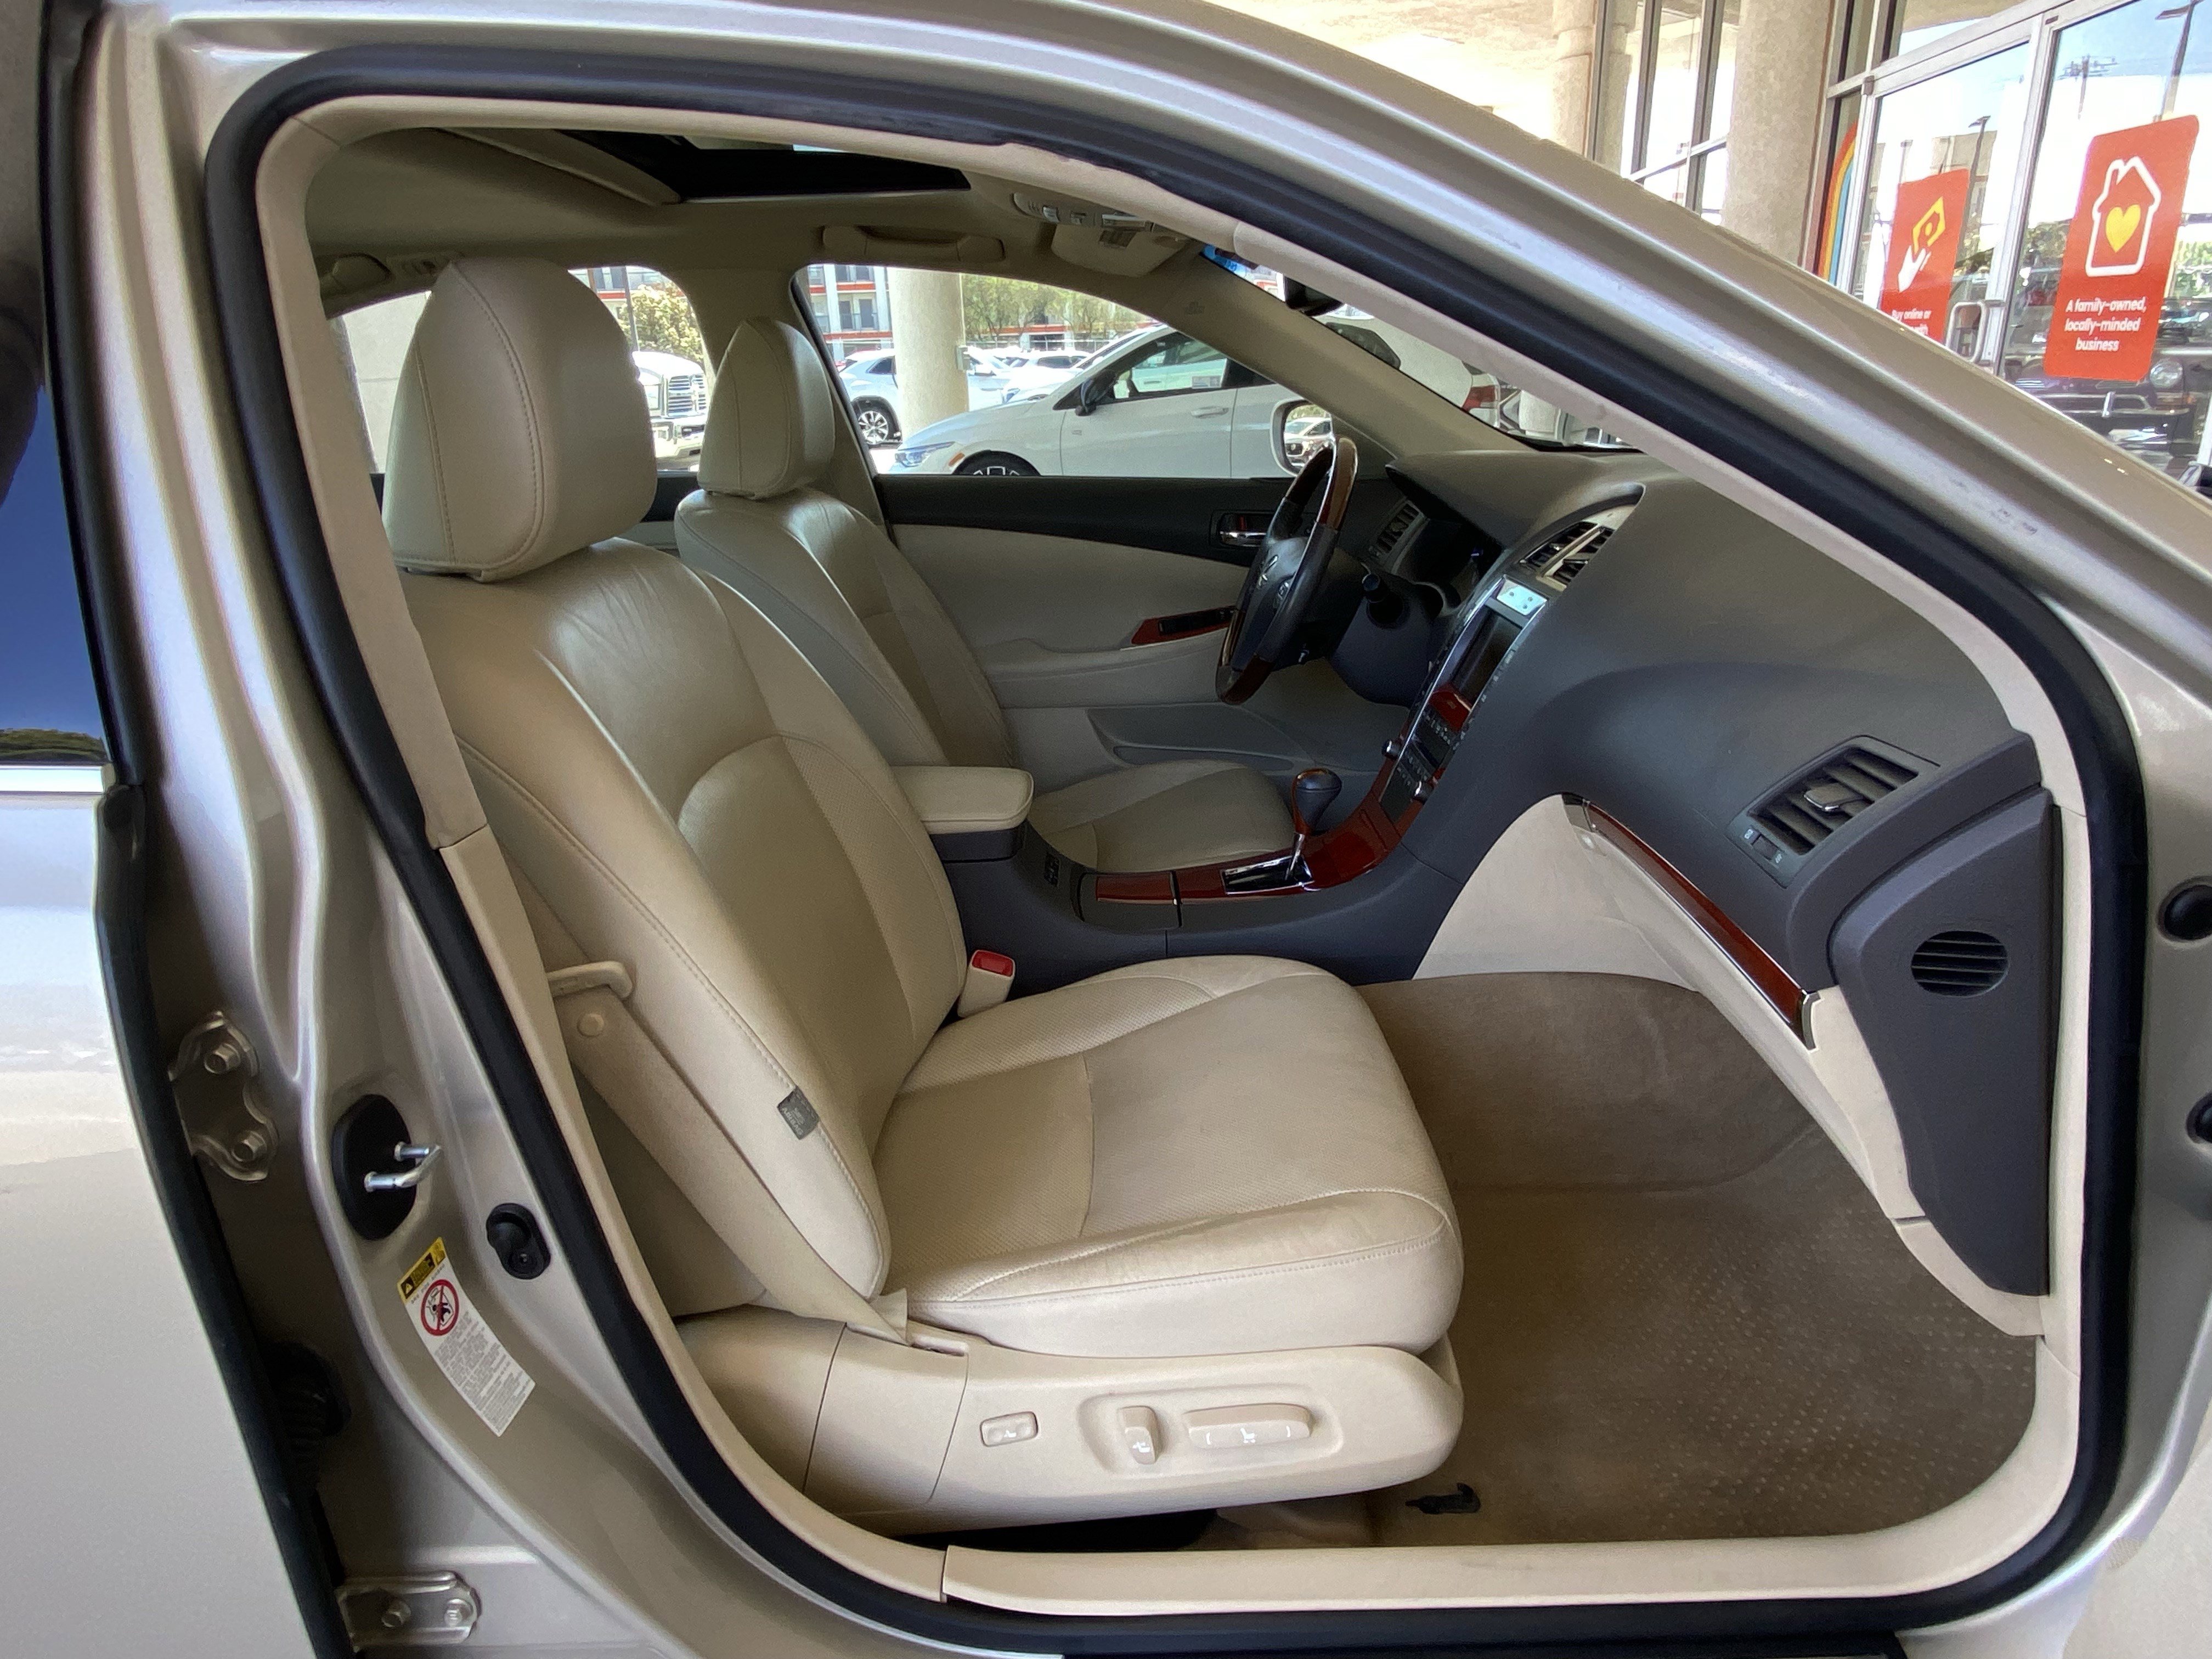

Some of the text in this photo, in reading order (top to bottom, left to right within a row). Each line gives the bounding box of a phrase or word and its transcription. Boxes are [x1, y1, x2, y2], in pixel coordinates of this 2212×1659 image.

[2065, 296, 2147, 316] A family-owned,
[2064, 317, 2142, 336] locally-minded
[2075, 336, 2120, 352] business
